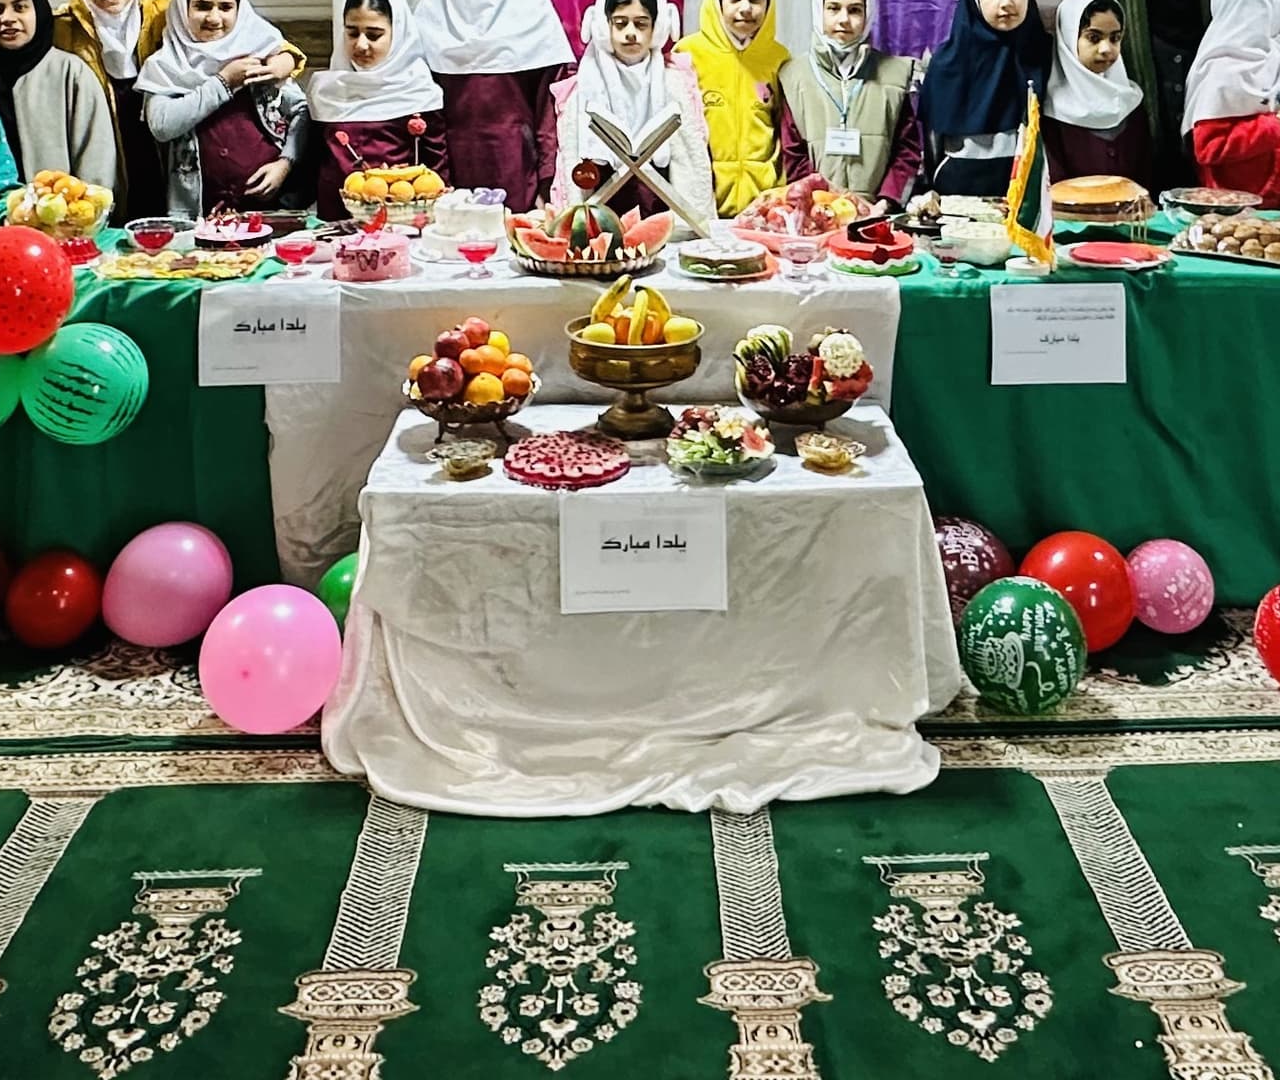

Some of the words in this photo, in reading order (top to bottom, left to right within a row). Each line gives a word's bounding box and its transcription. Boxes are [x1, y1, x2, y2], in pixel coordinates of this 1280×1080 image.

[233, 317, 276, 335] مبارک
[280, 317, 307, 334] یلدا
[601, 533, 651, 554] مبارک
[656, 533, 687, 553] یلدا
